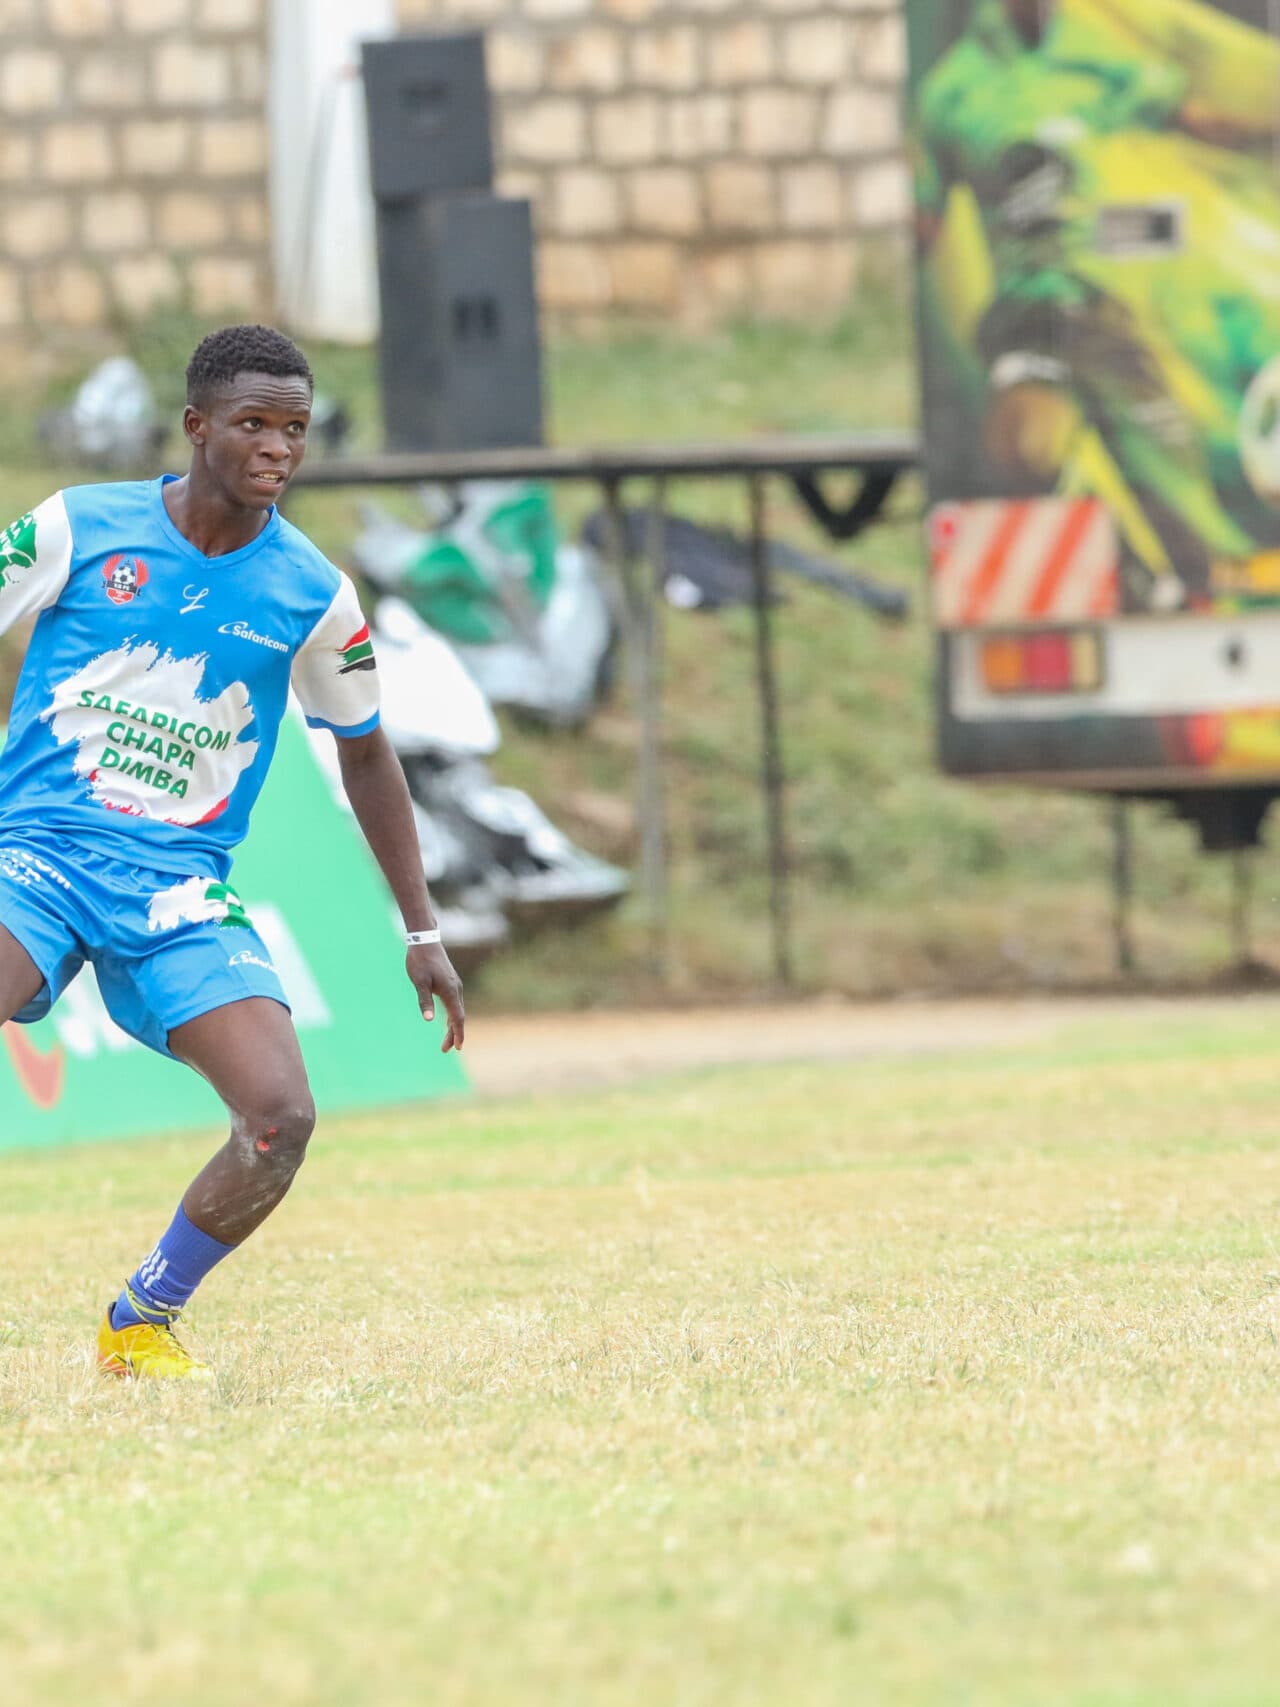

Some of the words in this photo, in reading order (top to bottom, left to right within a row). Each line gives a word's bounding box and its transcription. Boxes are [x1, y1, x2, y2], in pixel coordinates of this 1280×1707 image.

[231, 624, 289, 654] Safaricom
[76, 690, 232, 751] SAFARICOM
[106, 721, 196, 771] CHAPA
[98, 747, 190, 799] DIMBA
